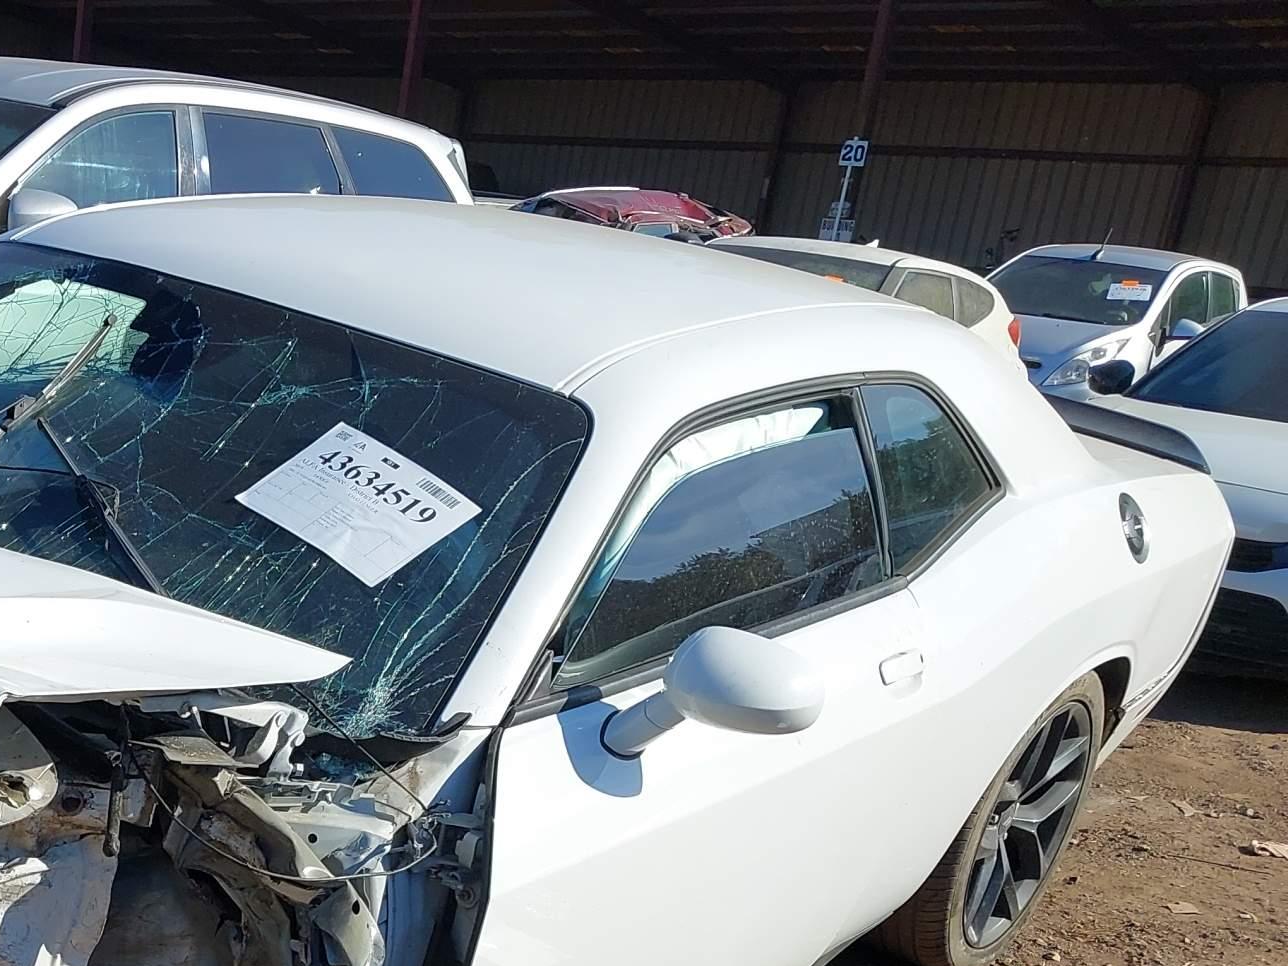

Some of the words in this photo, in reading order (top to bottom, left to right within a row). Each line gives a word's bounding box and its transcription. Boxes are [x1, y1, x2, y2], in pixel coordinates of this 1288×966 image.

[842, 145, 865, 162] 20
[822, 220, 855, 231] BUIDING
[319, 451, 436, 522] 43634519
